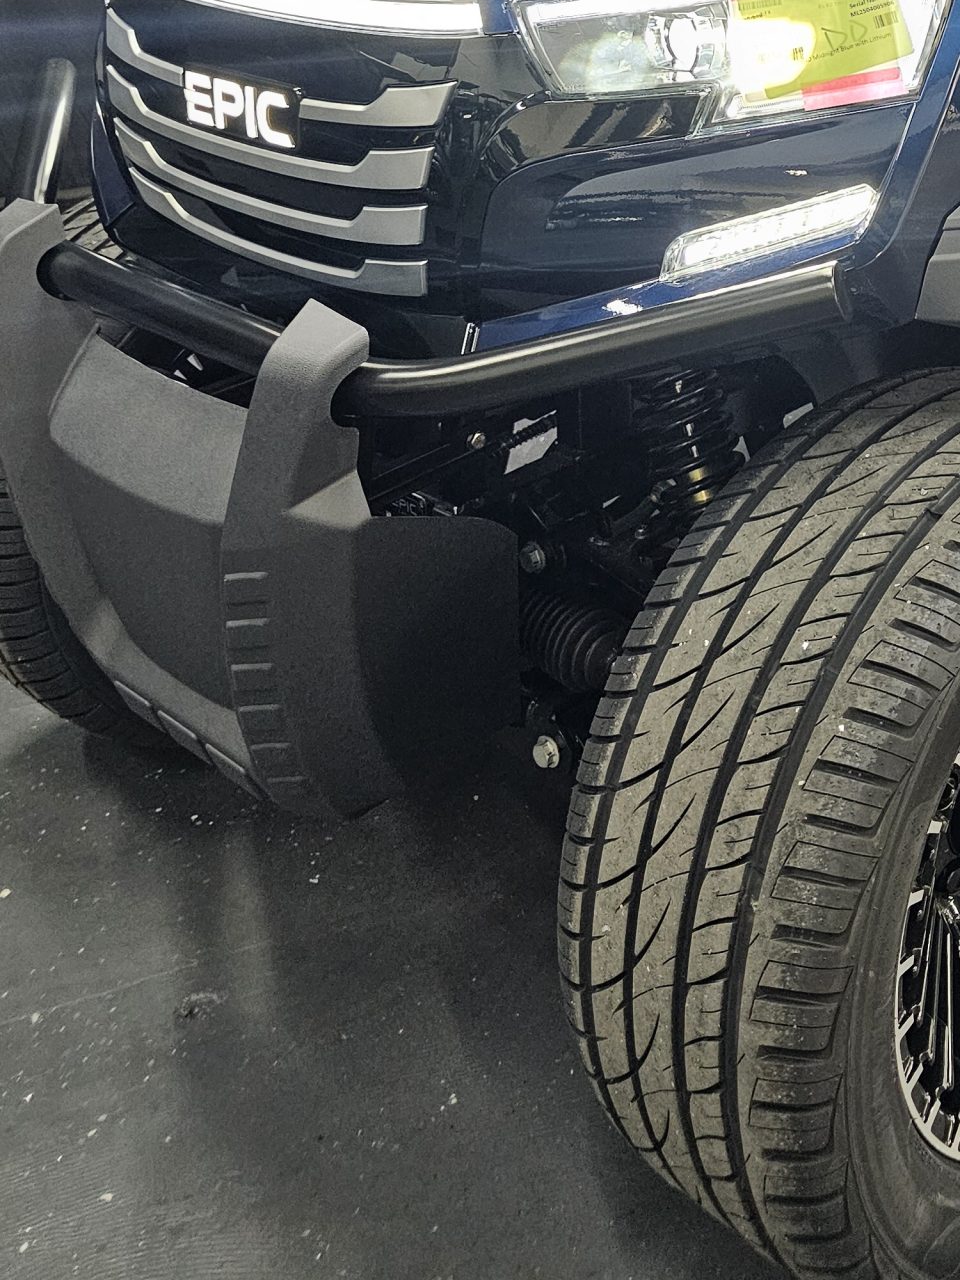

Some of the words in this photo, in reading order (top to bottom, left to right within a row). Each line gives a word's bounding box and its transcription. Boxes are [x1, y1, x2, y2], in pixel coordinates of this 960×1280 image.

[849, 0, 866, 9] Serial
[840, 44, 853, 52] Blue
[855, 38, 868, 47] with
[870, 32, 891, 42] Lithium
[184, 70, 296, 148] EPIC
